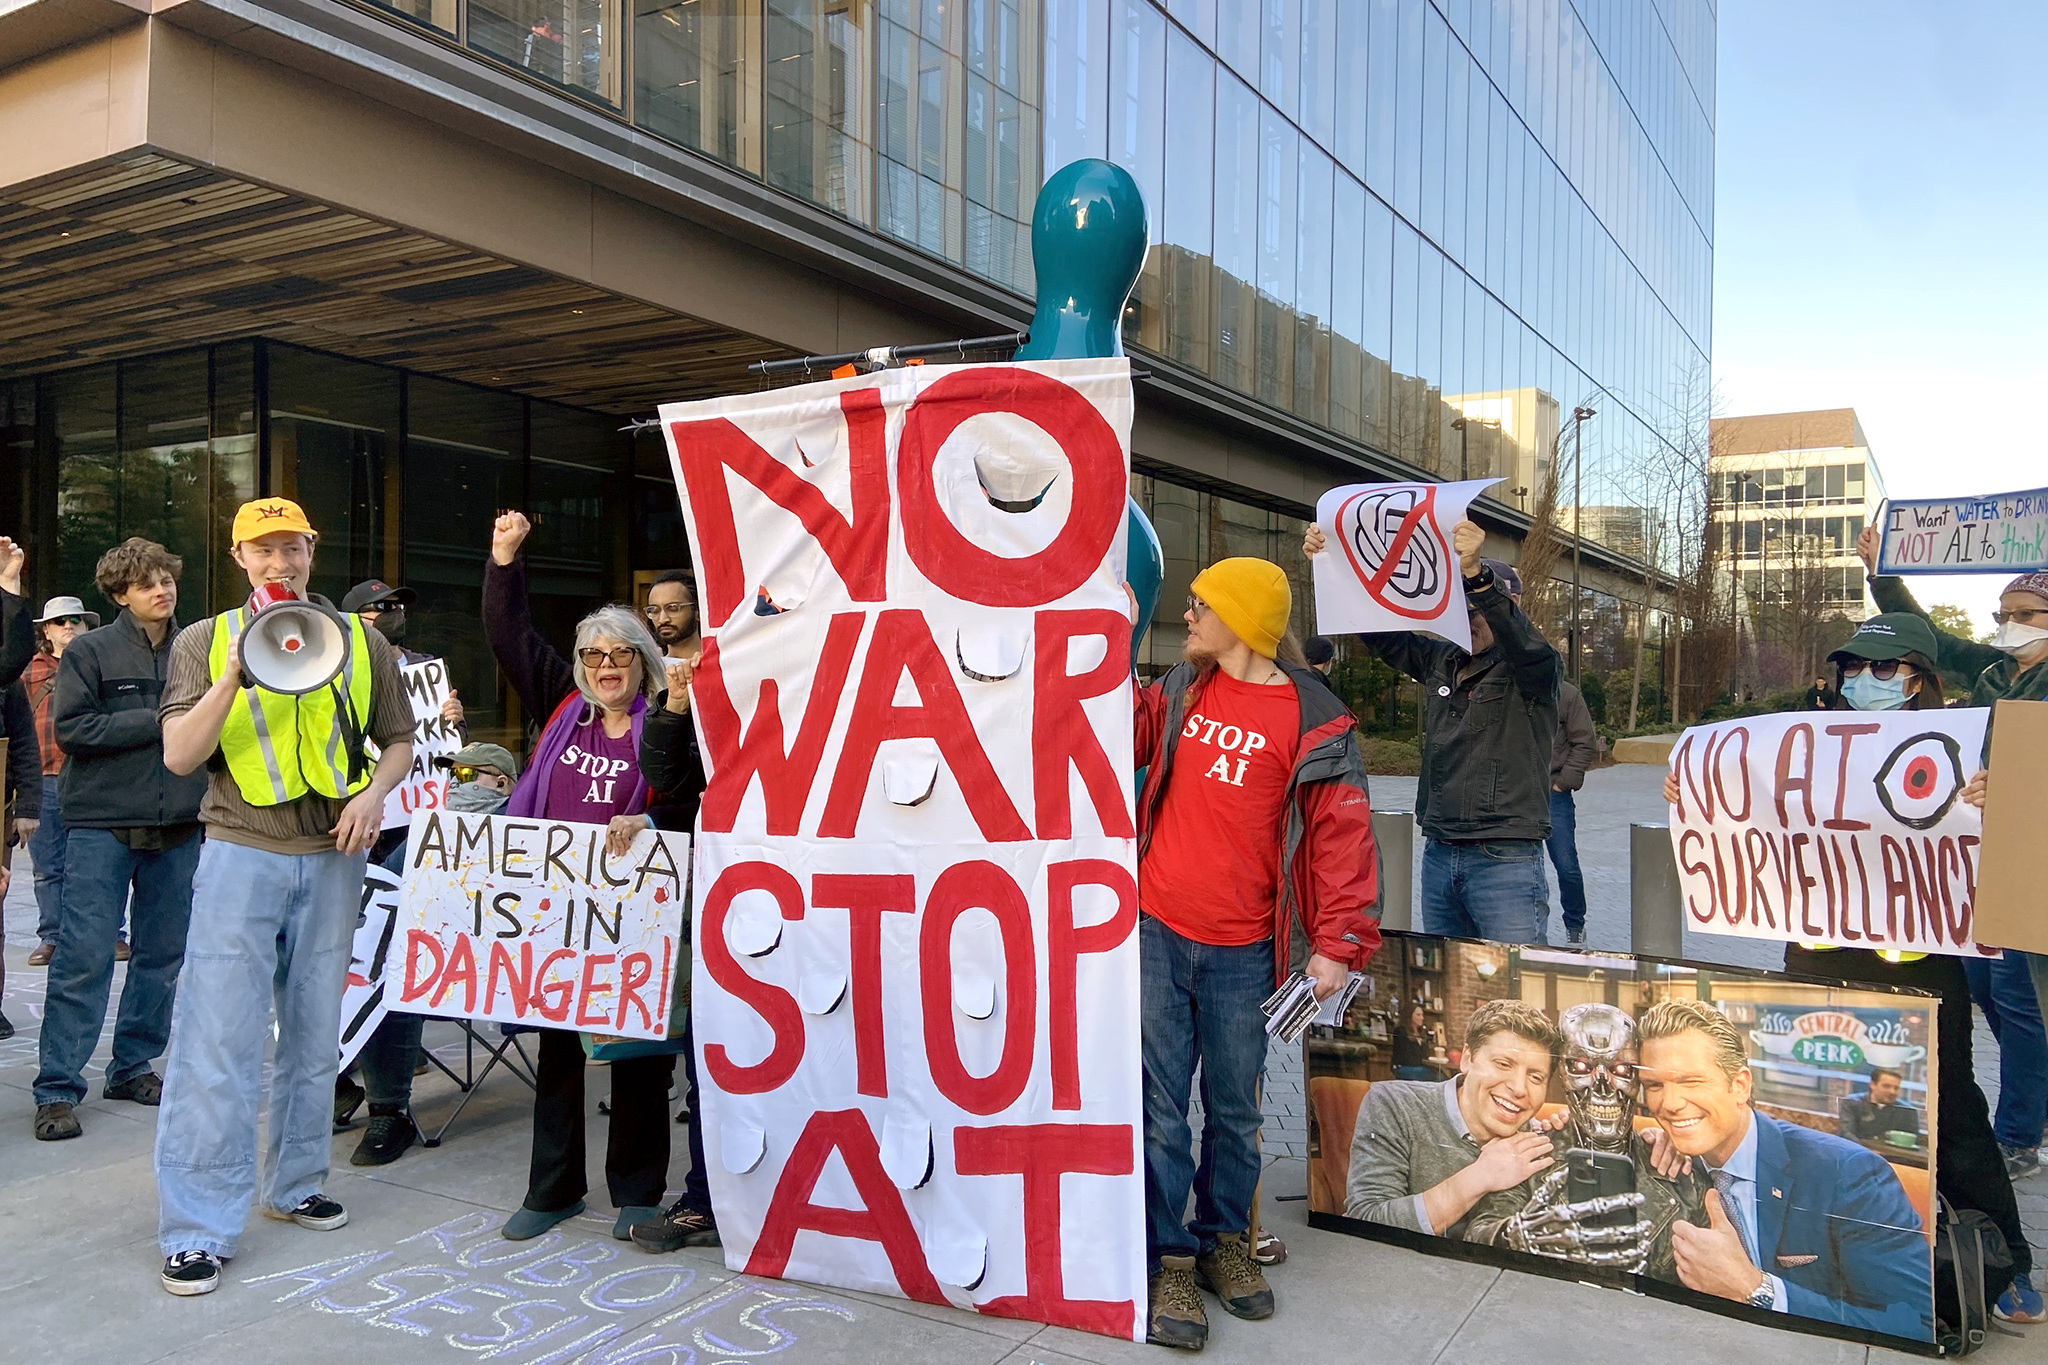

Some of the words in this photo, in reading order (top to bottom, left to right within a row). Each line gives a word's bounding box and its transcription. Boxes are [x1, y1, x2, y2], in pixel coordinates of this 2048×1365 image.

[671, 367, 1126, 628] NO
[1890, 508, 1905, 531] I
[1914, 505, 1950, 527] Want
[1955, 500, 1999, 522] WATER
[2003, 497, 2013, 518] to
[1894, 531, 1940, 565] NOT
[1943, 524, 1976, 563] AI
[1980, 523, 1995, 561] to
[693, 609, 1136, 842] WAR
[1182, 714, 1266, 756] STOP
[410, 750, 456, 782] AN
[560, 745, 629, 777] STOP
[1204, 754, 1250, 787] AI
[1674, 726, 1750, 825] NO
[1774, 722, 1881, 831] AI
[582, 780, 616, 803] AI
[414, 812, 680, 901] AMERICA
[474, 890, 522, 938] IS
[564, 897, 622, 950] IN
[400, 929, 671, 1035] DANGER!
[701, 859, 1139, 1116] STOP
[1800, 1014, 1860, 1040] CENTRAL
[1802, 1040, 1855, 1064] PERK
[743, 1108, 1135, 1341] AI
[395, 1210, 858, 1357] ROBOTS
